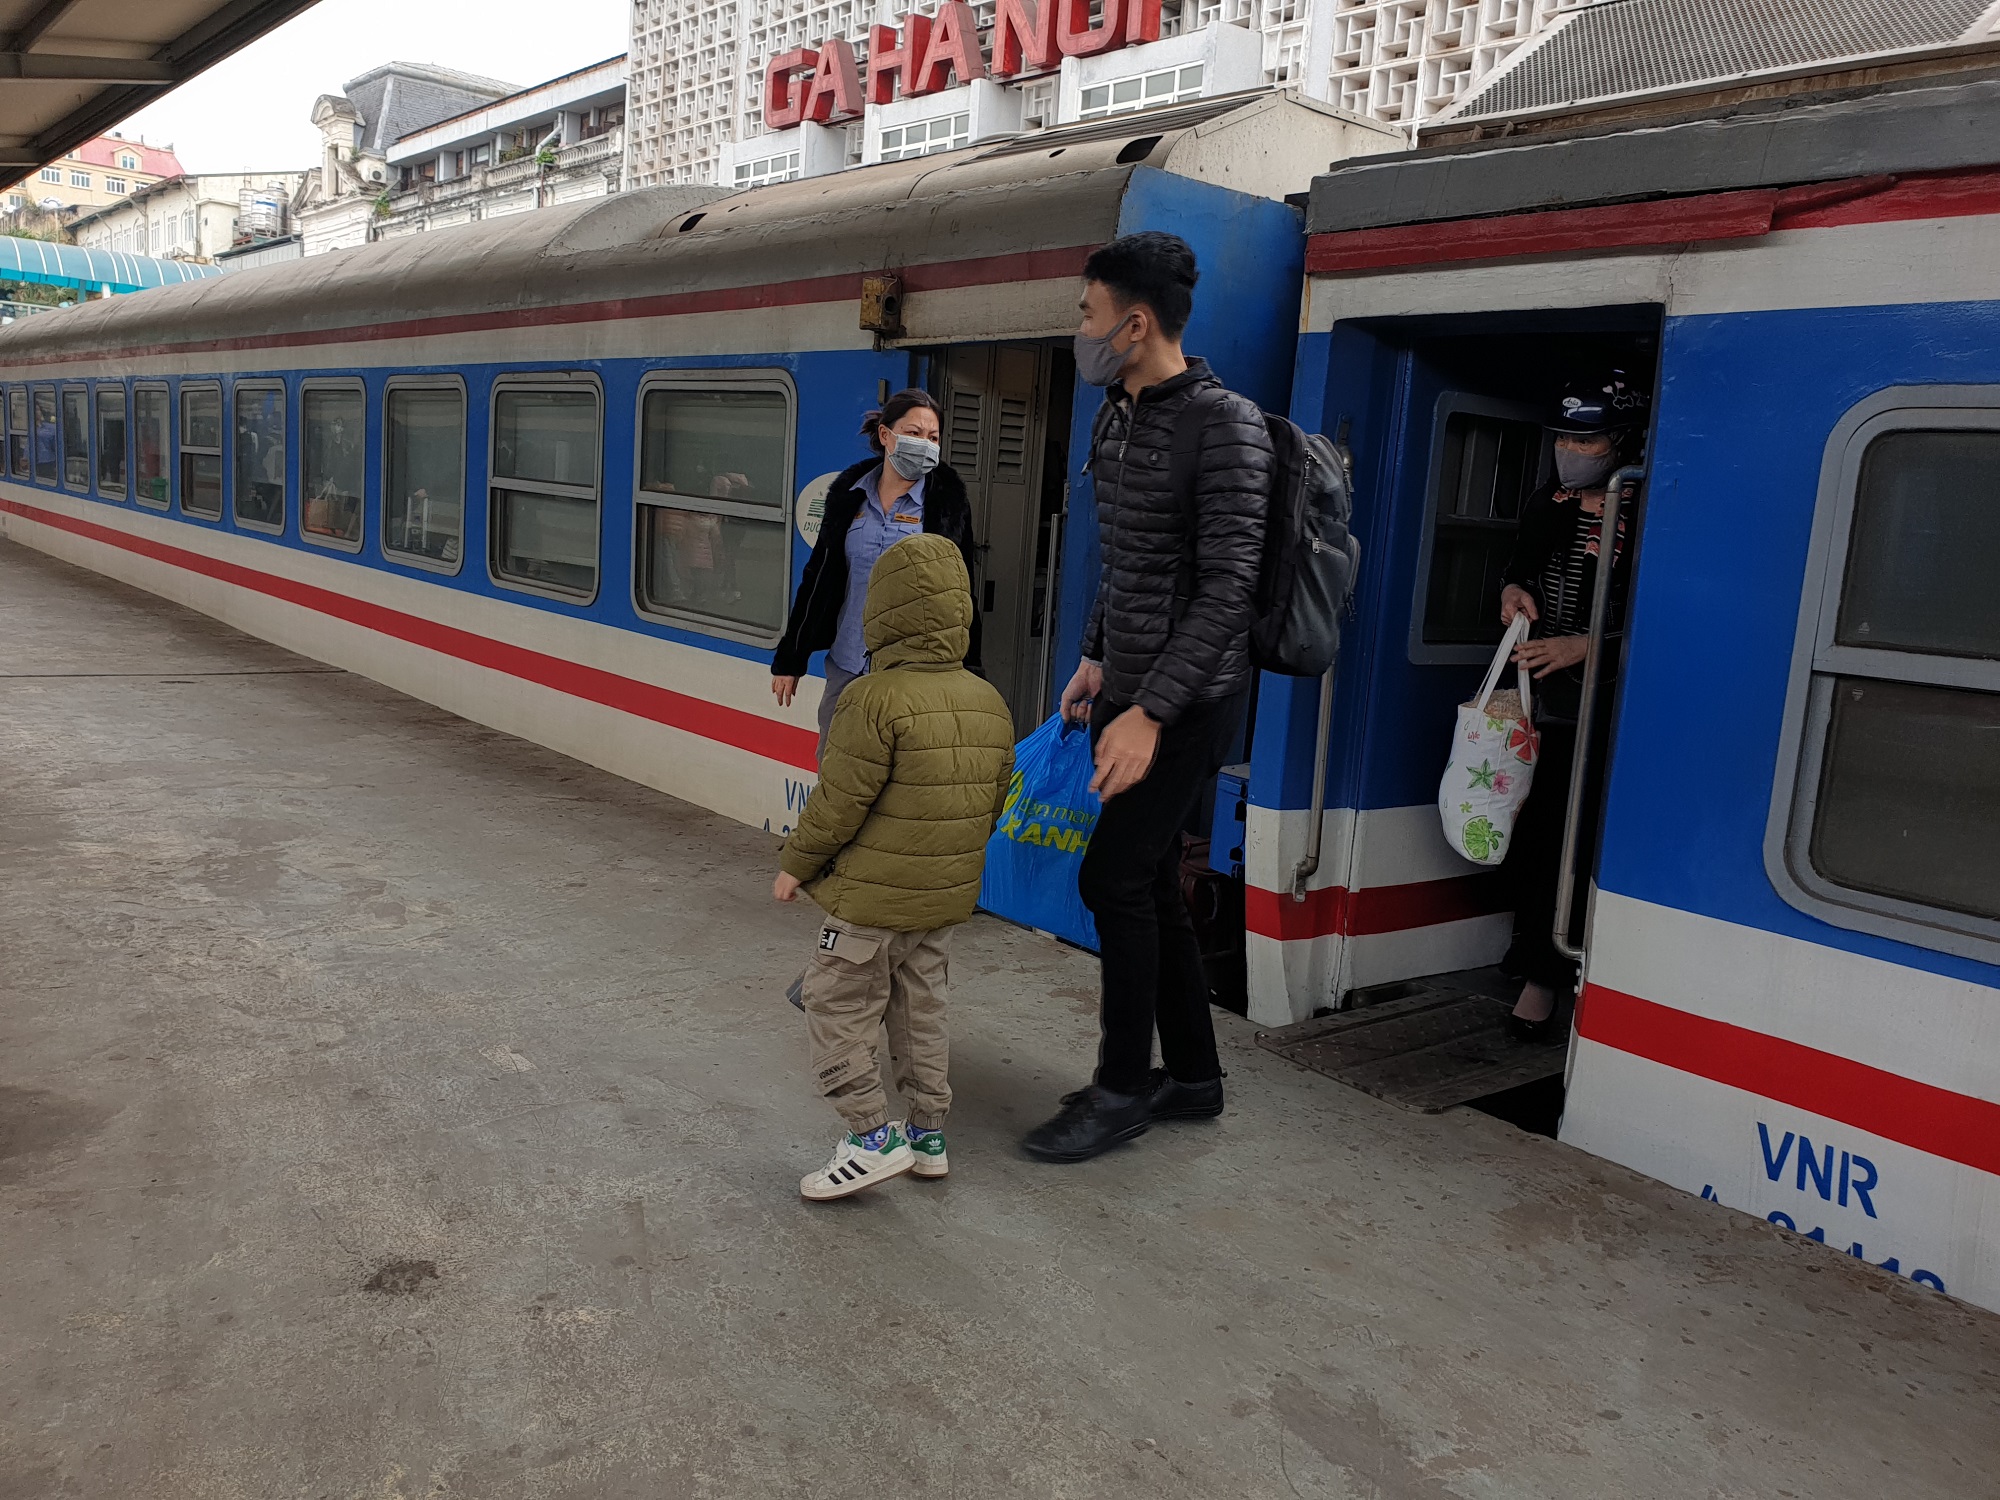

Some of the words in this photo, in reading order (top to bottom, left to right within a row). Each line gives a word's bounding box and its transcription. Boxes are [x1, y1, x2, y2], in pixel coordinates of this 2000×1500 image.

[765, 39, 864, 130] GA
[1001, 812, 1092, 856] XANH
[1757, 1121, 1878, 1220] VNR
